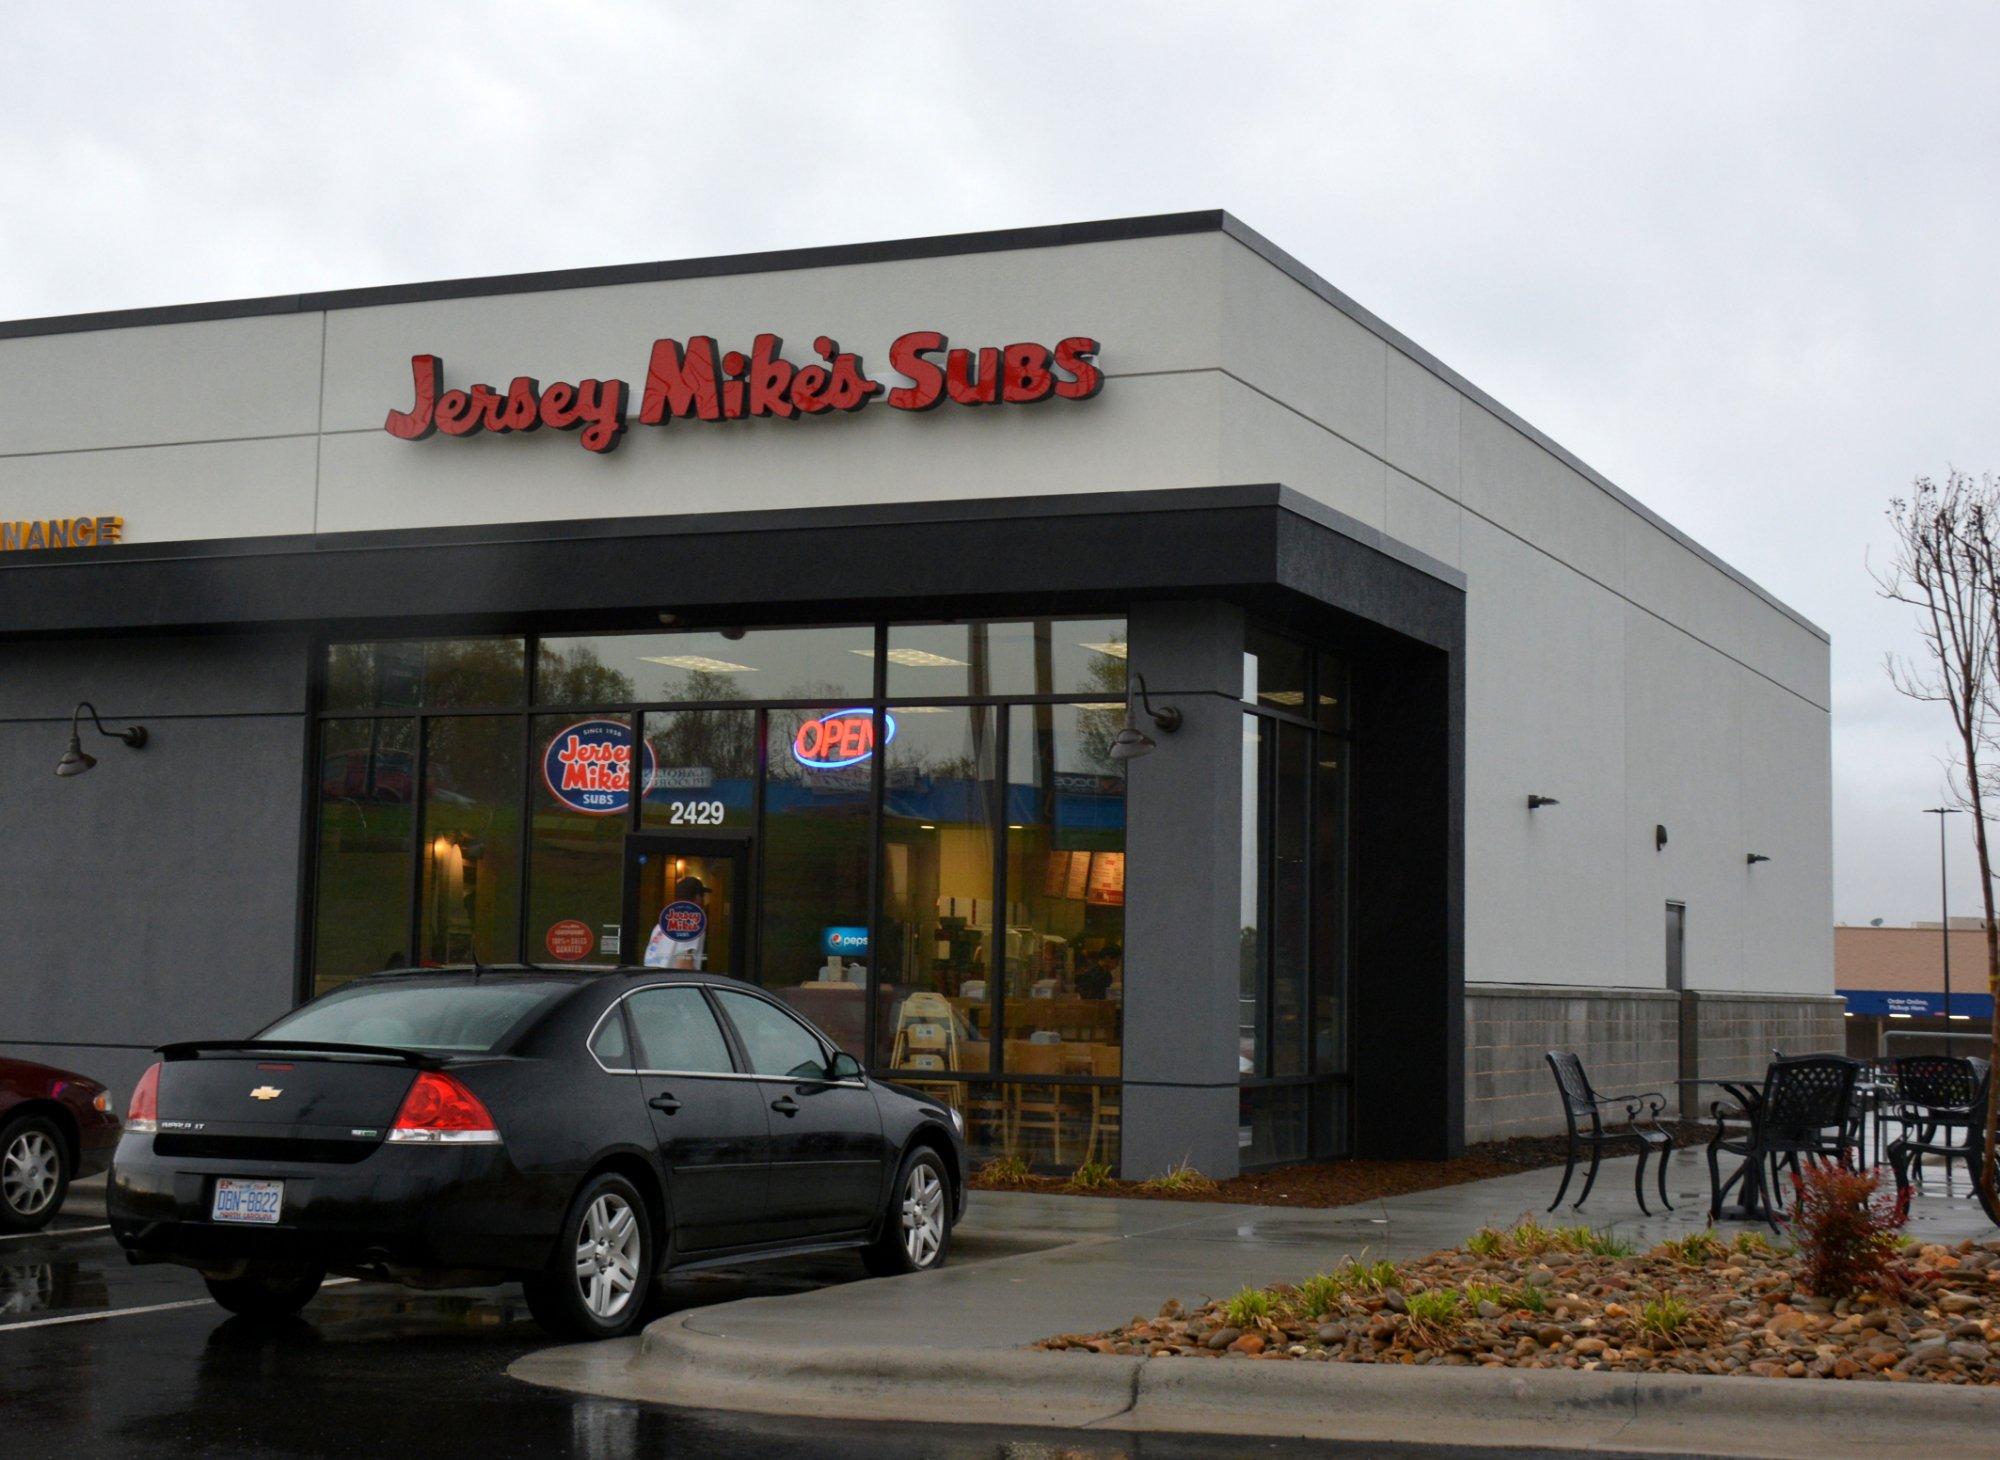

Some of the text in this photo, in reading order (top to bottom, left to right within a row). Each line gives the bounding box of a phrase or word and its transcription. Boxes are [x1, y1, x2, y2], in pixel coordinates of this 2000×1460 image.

[385, 331, 1104, 453] Jersey Mike's SUBS
[583, 794, 614, 804] SUBS
[670, 801, 724, 824] 2429
[665, 909, 701, 923] Jersey
[843, 937, 868, 947] peps
